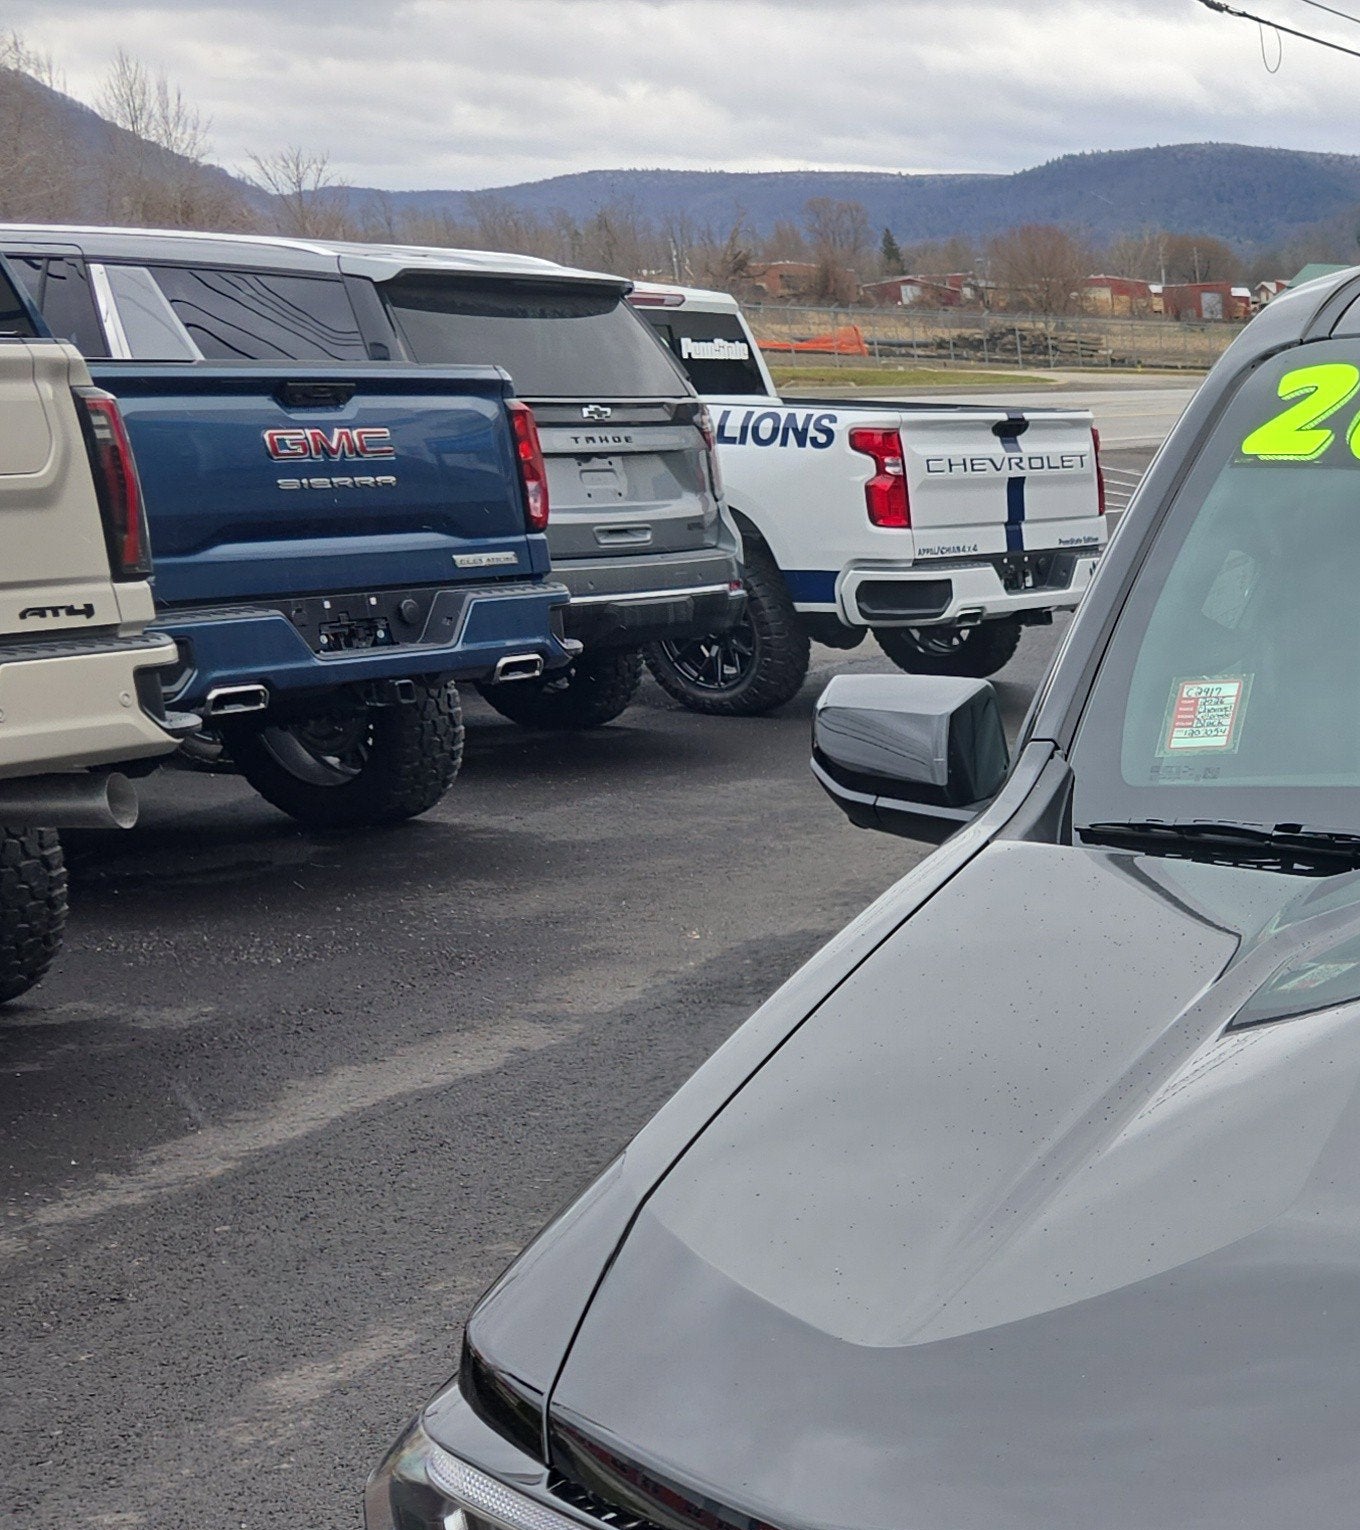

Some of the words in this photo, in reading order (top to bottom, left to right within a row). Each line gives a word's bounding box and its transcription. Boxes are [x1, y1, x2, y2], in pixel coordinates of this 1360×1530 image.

[717, 410, 838, 450] LIONS
[263, 427, 397, 462] GMC
[570, 436, 634, 444] TAHOE
[926, 454, 1088, 473] CHEVROLET
[276, 475, 397, 490] SIERRA
[18, 603, 95, 620] AT4
